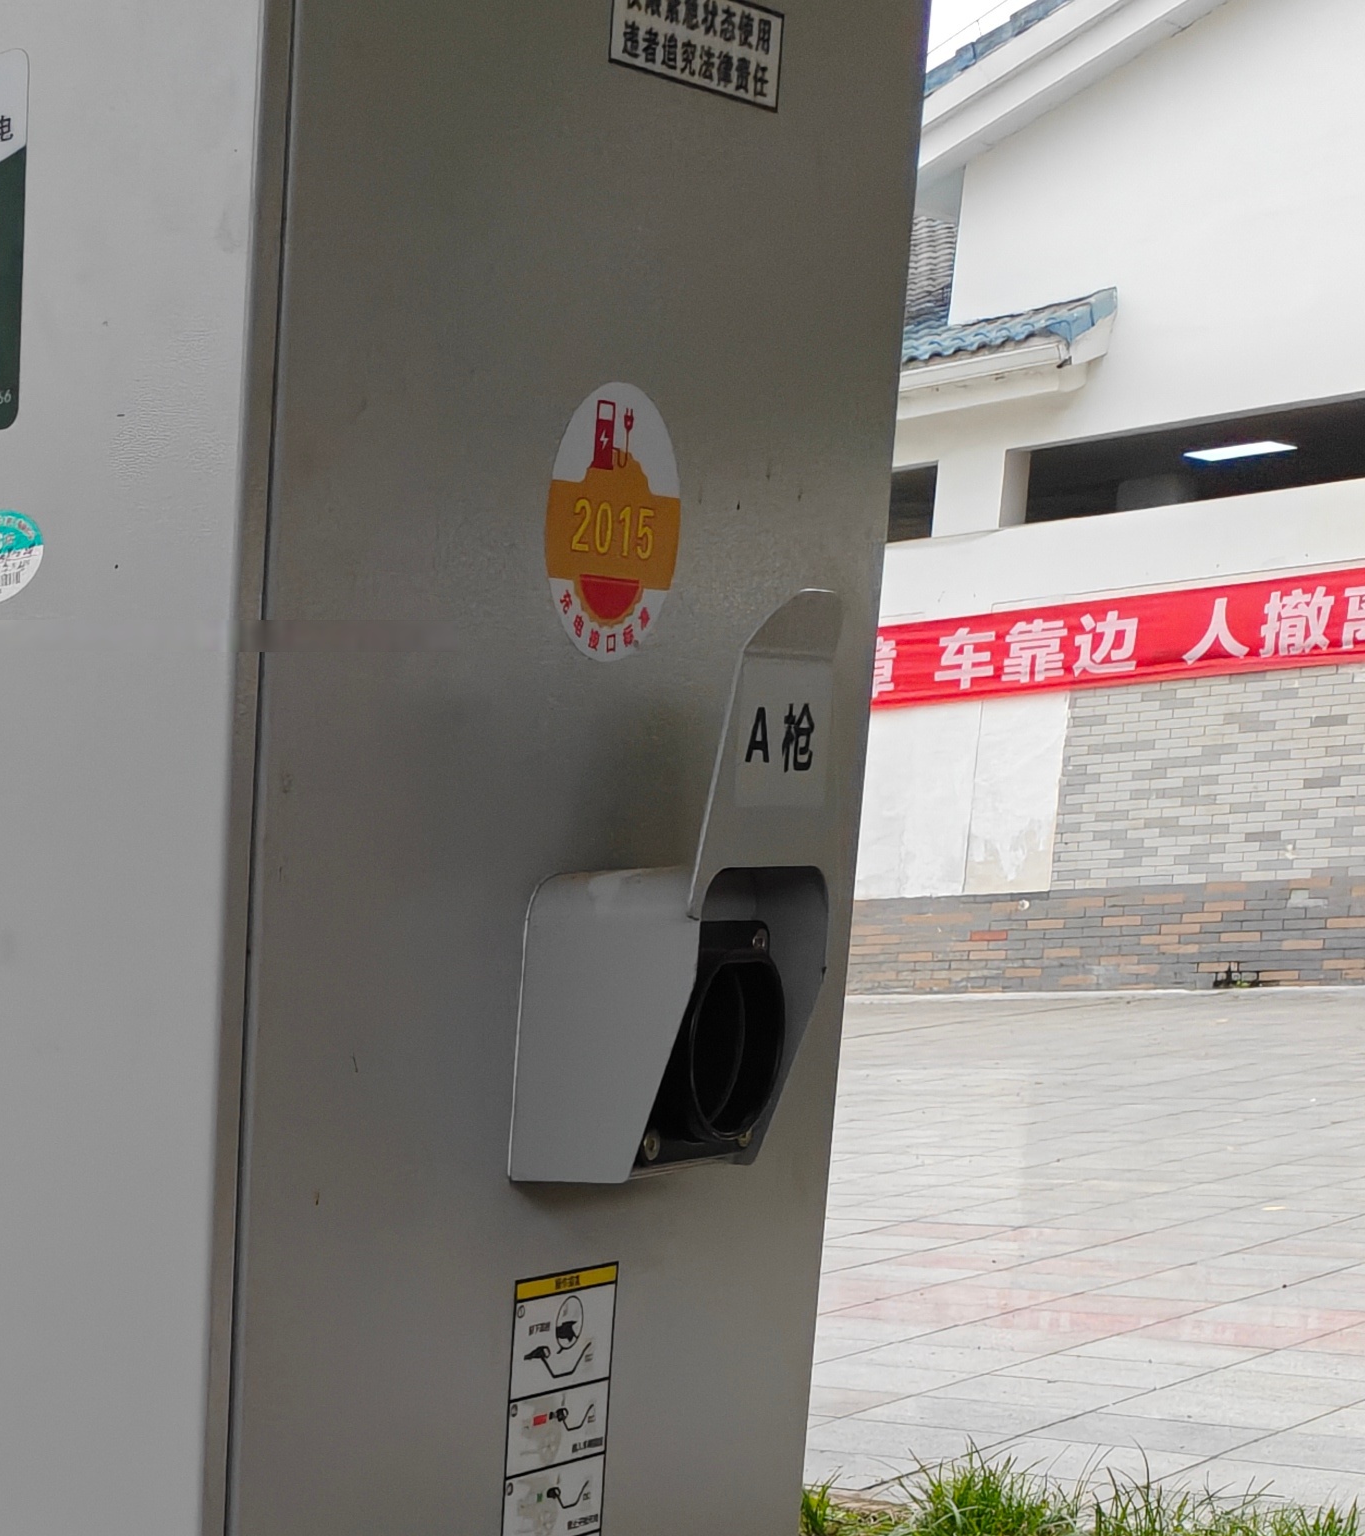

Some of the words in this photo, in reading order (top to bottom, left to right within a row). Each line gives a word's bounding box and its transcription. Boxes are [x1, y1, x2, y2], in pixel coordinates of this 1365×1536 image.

[622, 20, 770, 97] 违者追究法律责任
[571, 498, 655, 560] 2015
[934, 610, 1139, 692] 车靠边
[745, 706, 770, 763] A
[782, 703, 815, 773] 枪
